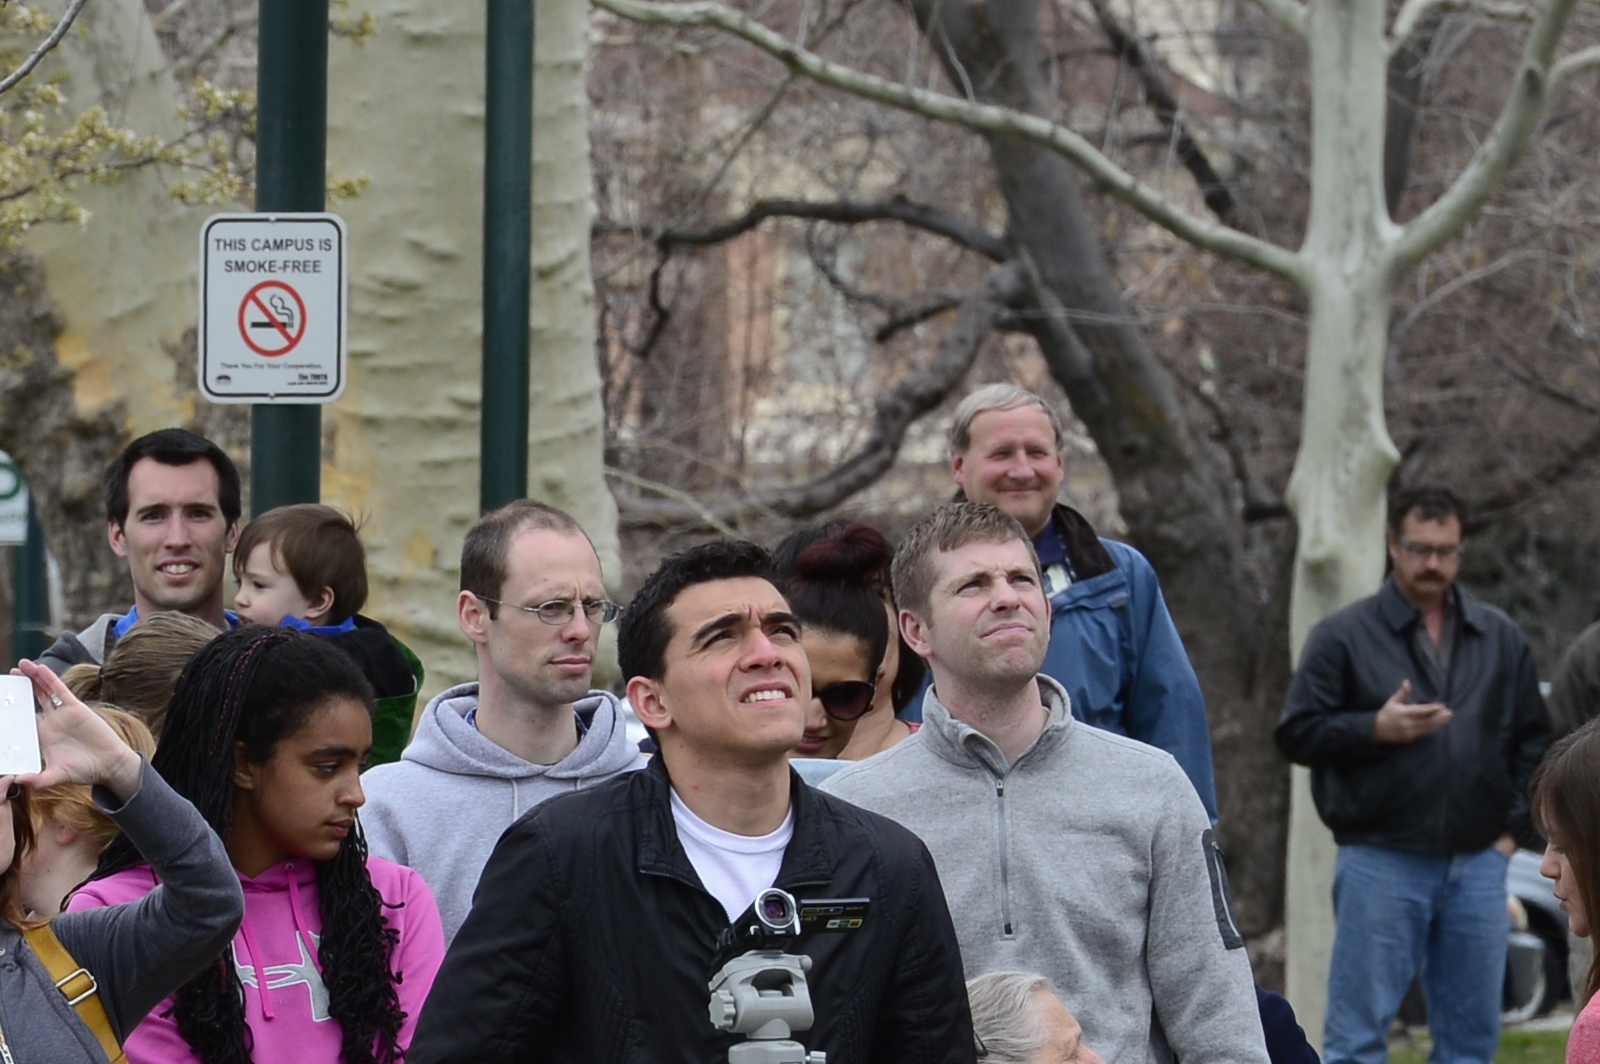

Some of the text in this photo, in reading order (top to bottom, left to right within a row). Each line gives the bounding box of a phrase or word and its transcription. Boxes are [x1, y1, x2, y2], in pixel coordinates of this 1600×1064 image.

[214, 238, 332, 252] THIS CAMPUS IS
[224, 260, 321, 273] SMOKE-FREE
